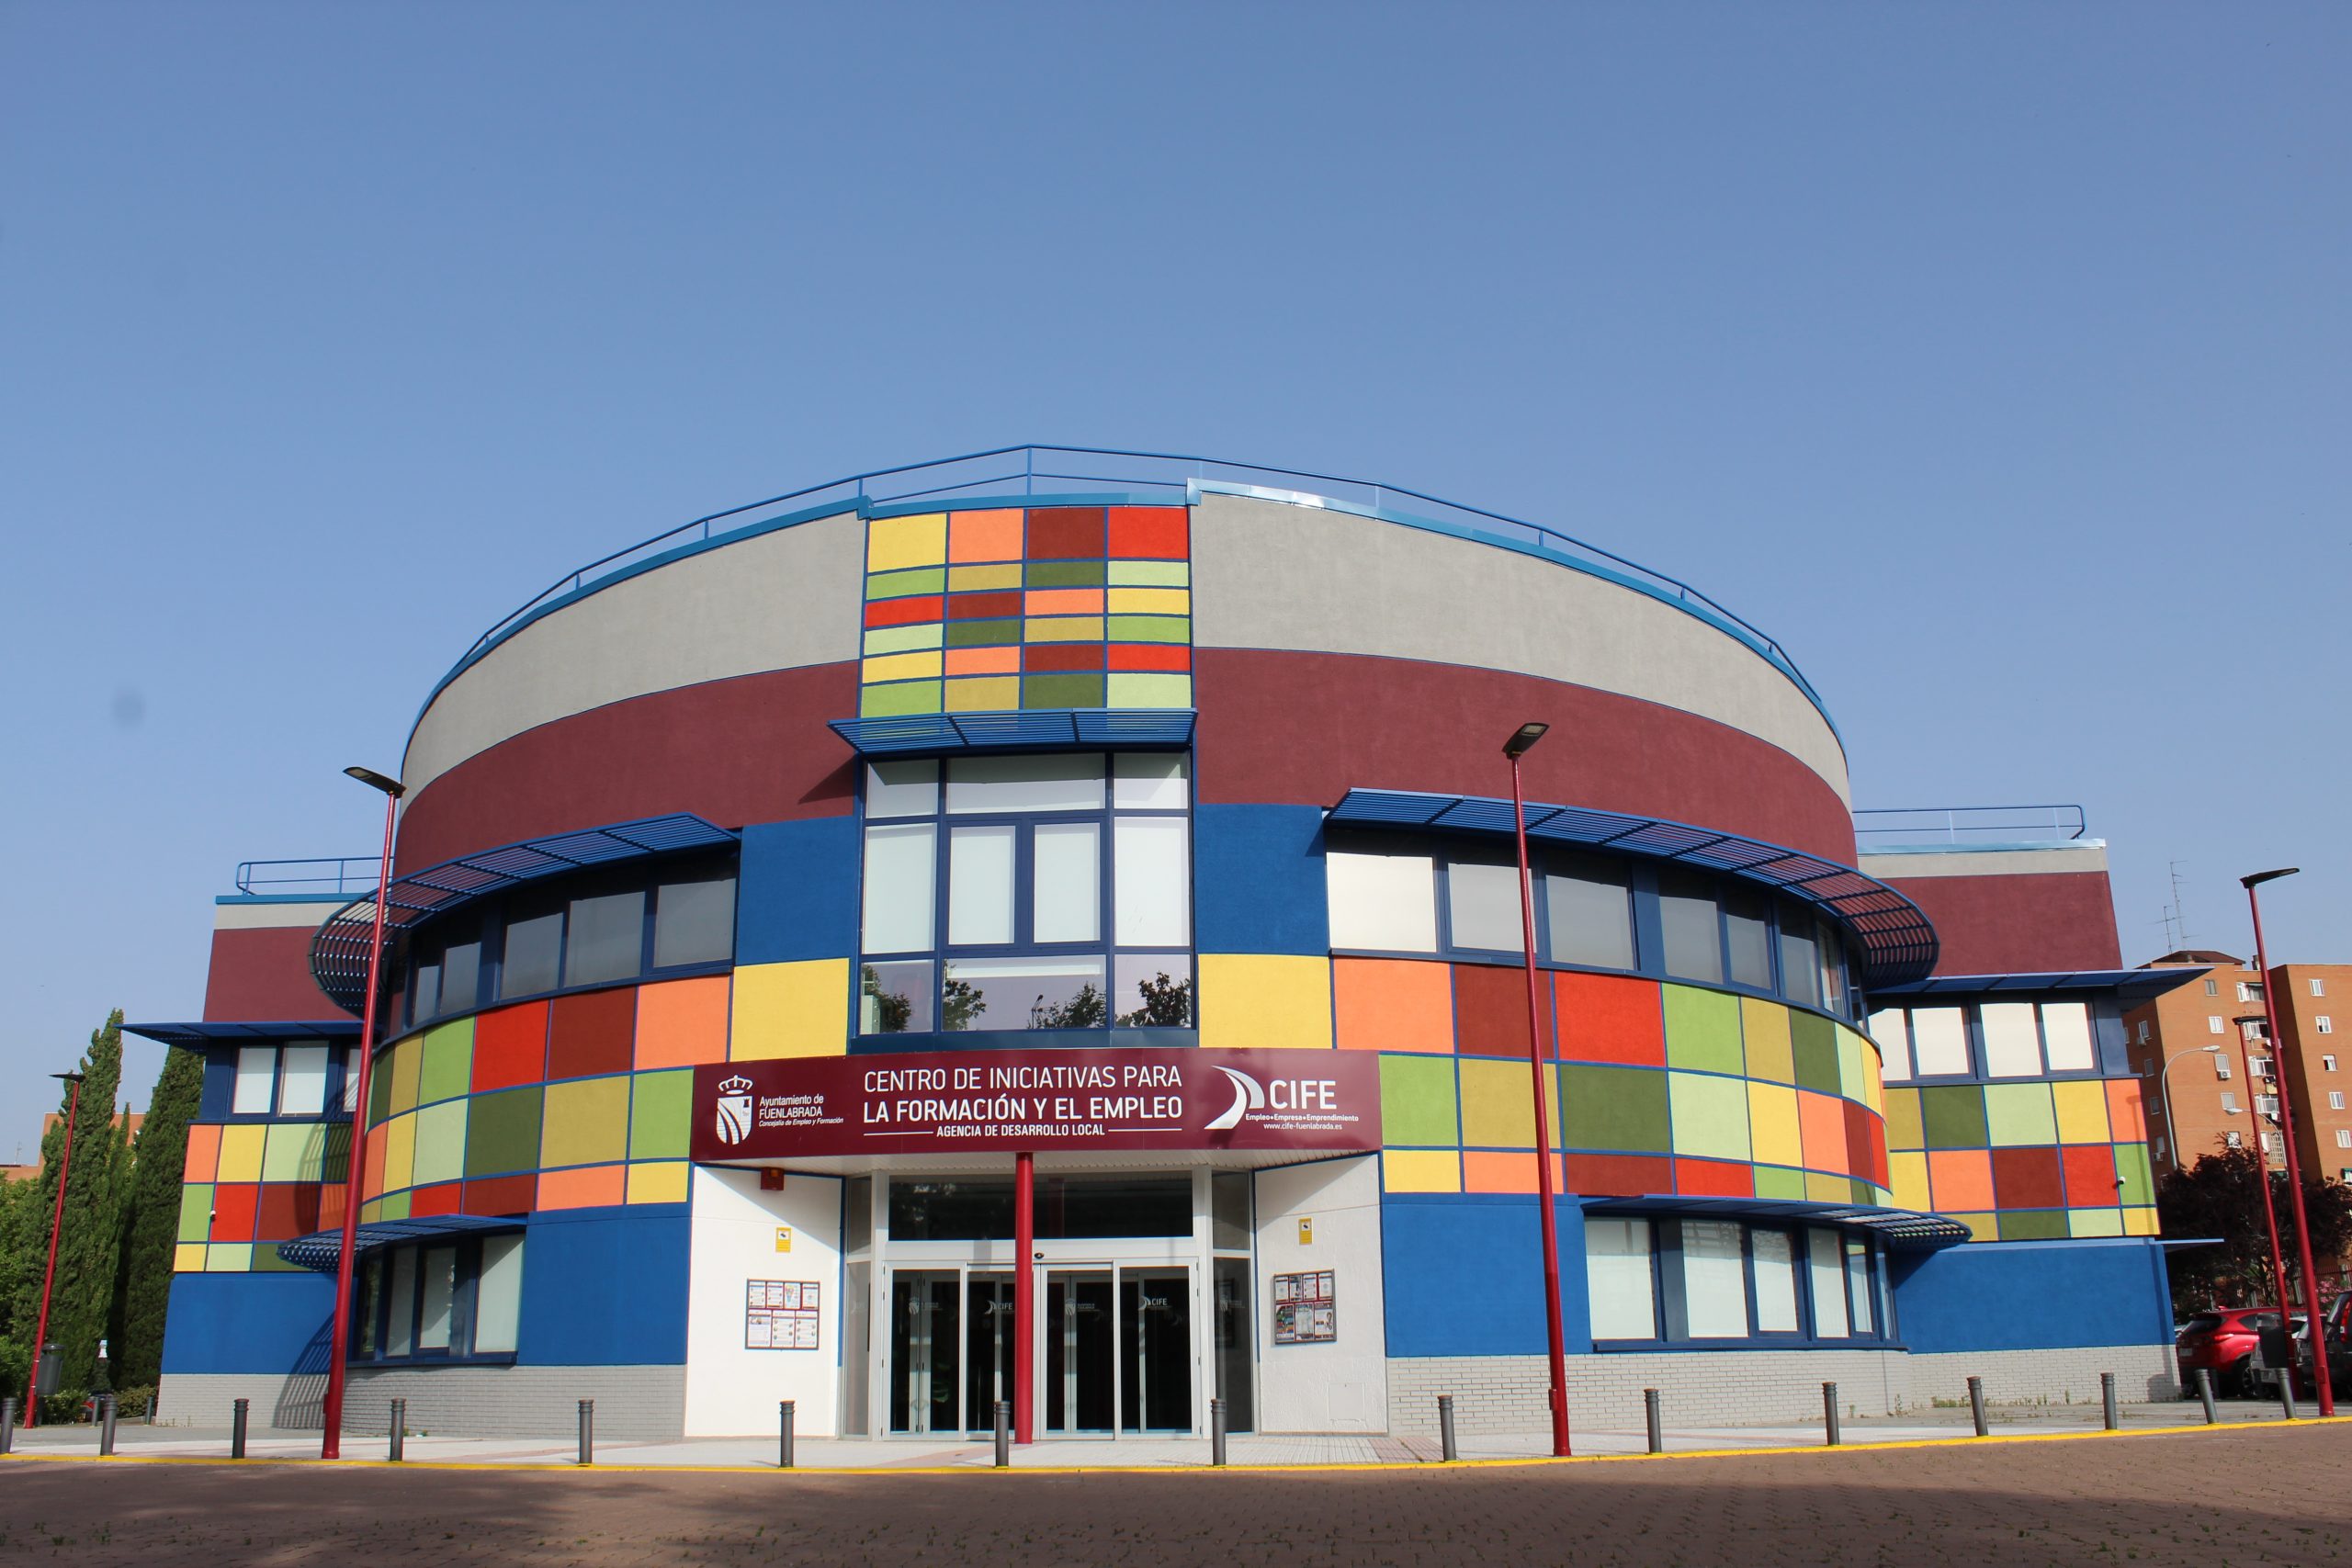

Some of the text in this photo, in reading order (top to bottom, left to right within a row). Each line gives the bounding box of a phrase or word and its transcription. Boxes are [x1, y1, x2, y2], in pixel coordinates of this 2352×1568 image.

[865, 1066, 1182, 1093] CENTRO DE INICIATIVAS PARA
[759, 1093, 824, 1108] Ayuntamiento de
[1270, 1079, 1337, 1110] CIFE
[759, 1106, 823, 1119] FUENLABRADA
[863, 1093, 1182, 1123] LA FORMACIÓN Y EL EMPLEO
[936, 1123, 1105, 1137] AGENCIA DE DESARROLLO LOCAL
[1151, 1297, 1168, 1306] CIFE
